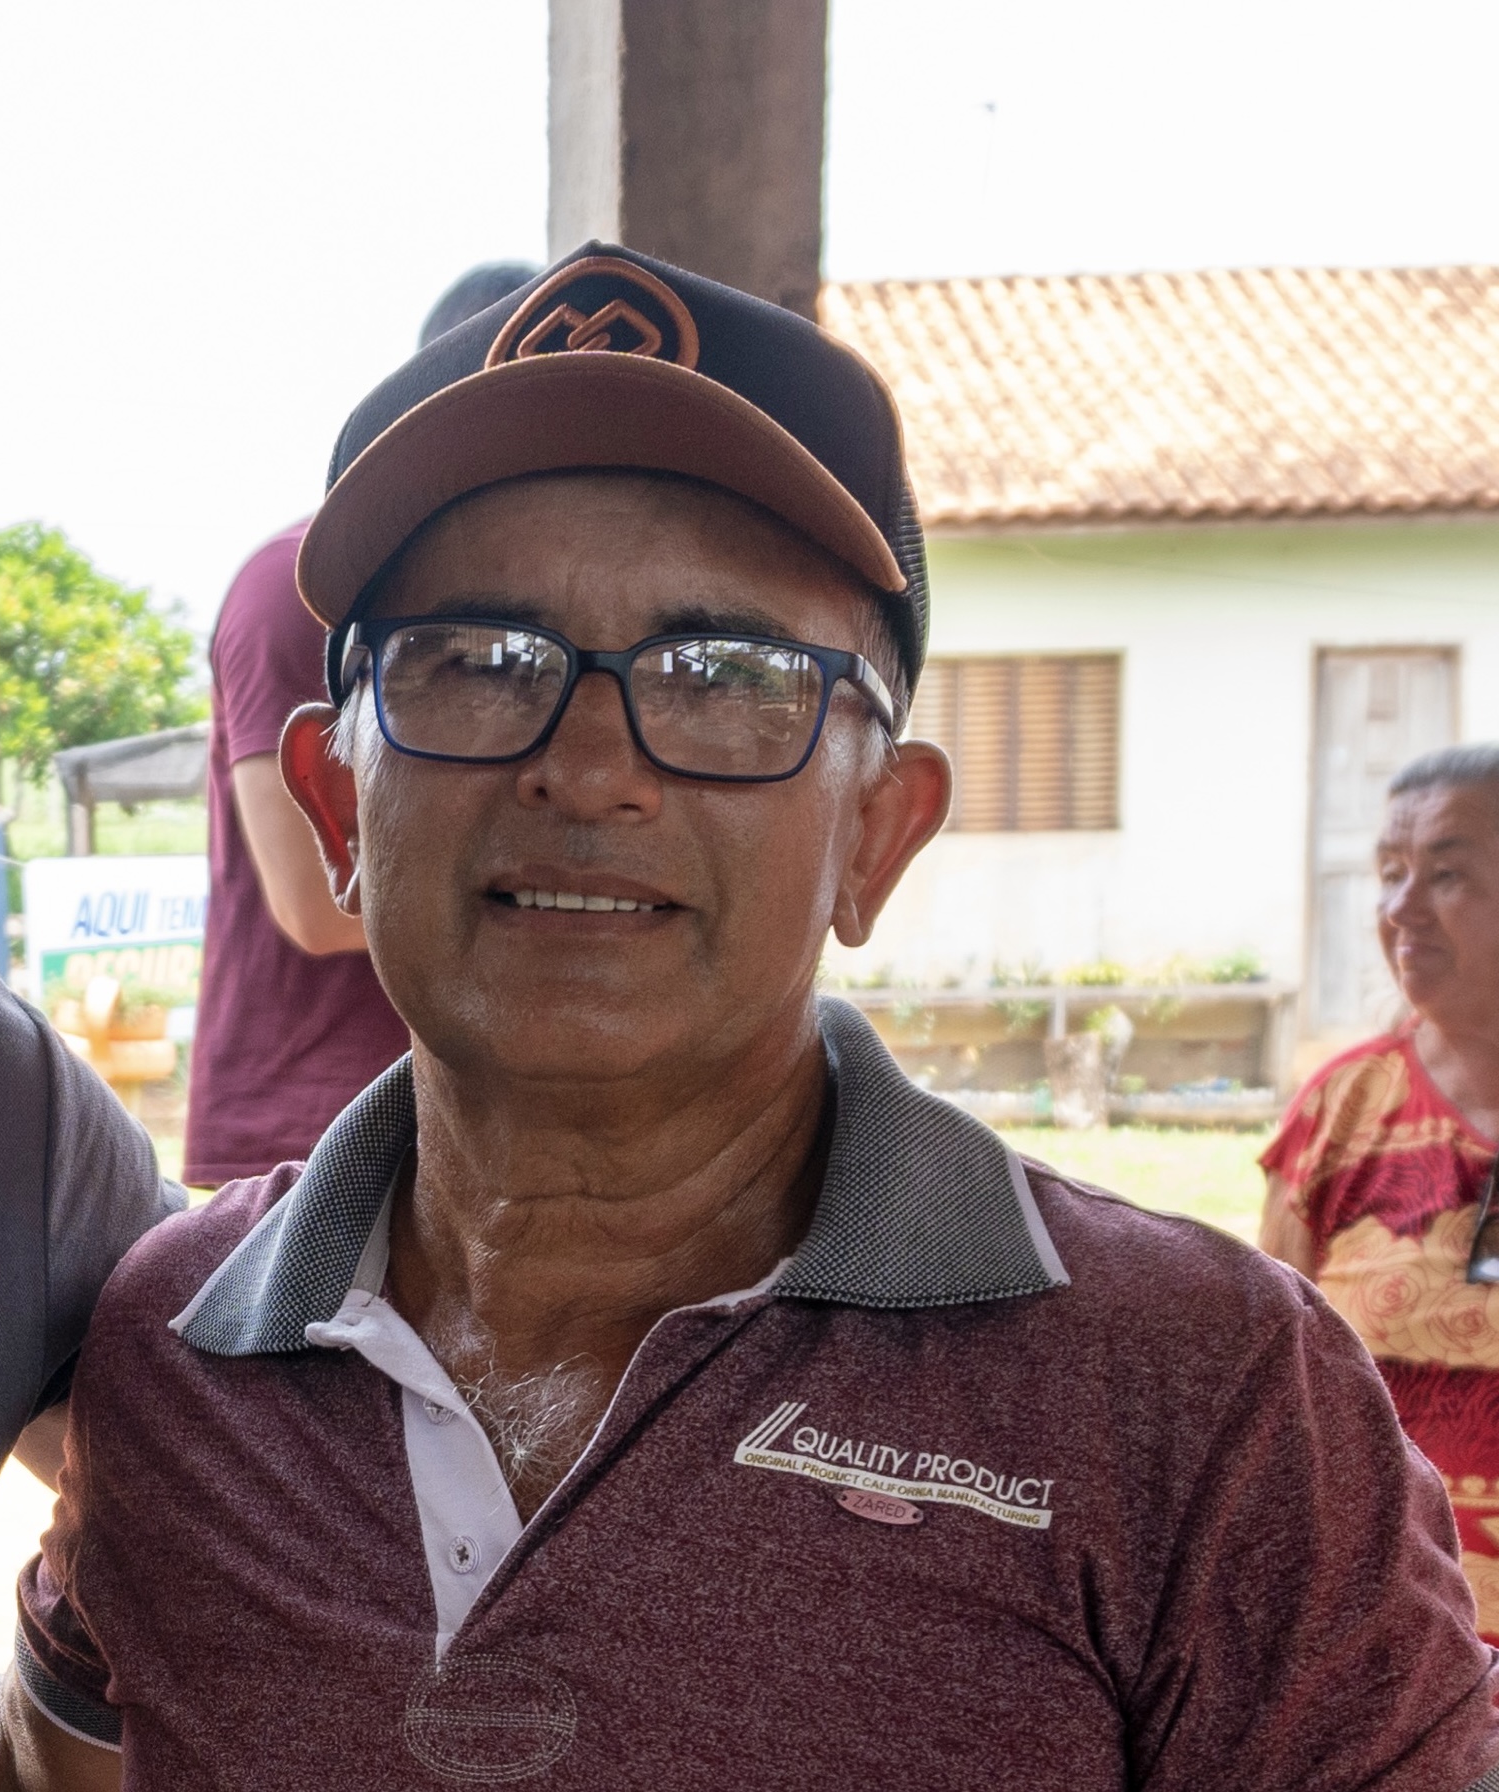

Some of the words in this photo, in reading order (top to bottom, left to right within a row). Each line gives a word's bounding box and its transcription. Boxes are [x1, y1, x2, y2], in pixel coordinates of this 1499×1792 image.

[69, 889, 151, 938] AQUI
[744, 1452, 799, 1471] ORIGINAL
[802, 1462, 860, 1484] PRODUCT
[862, 1477, 933, 1498] CALIFORNIA
[937, 1487, 1041, 1525] MANUFACTURING
[792, 1426, 911, 1475] QUALITY
[913, 1452, 1055, 1507] PRODUCT
[853, 1494, 906, 1519] ZARED
